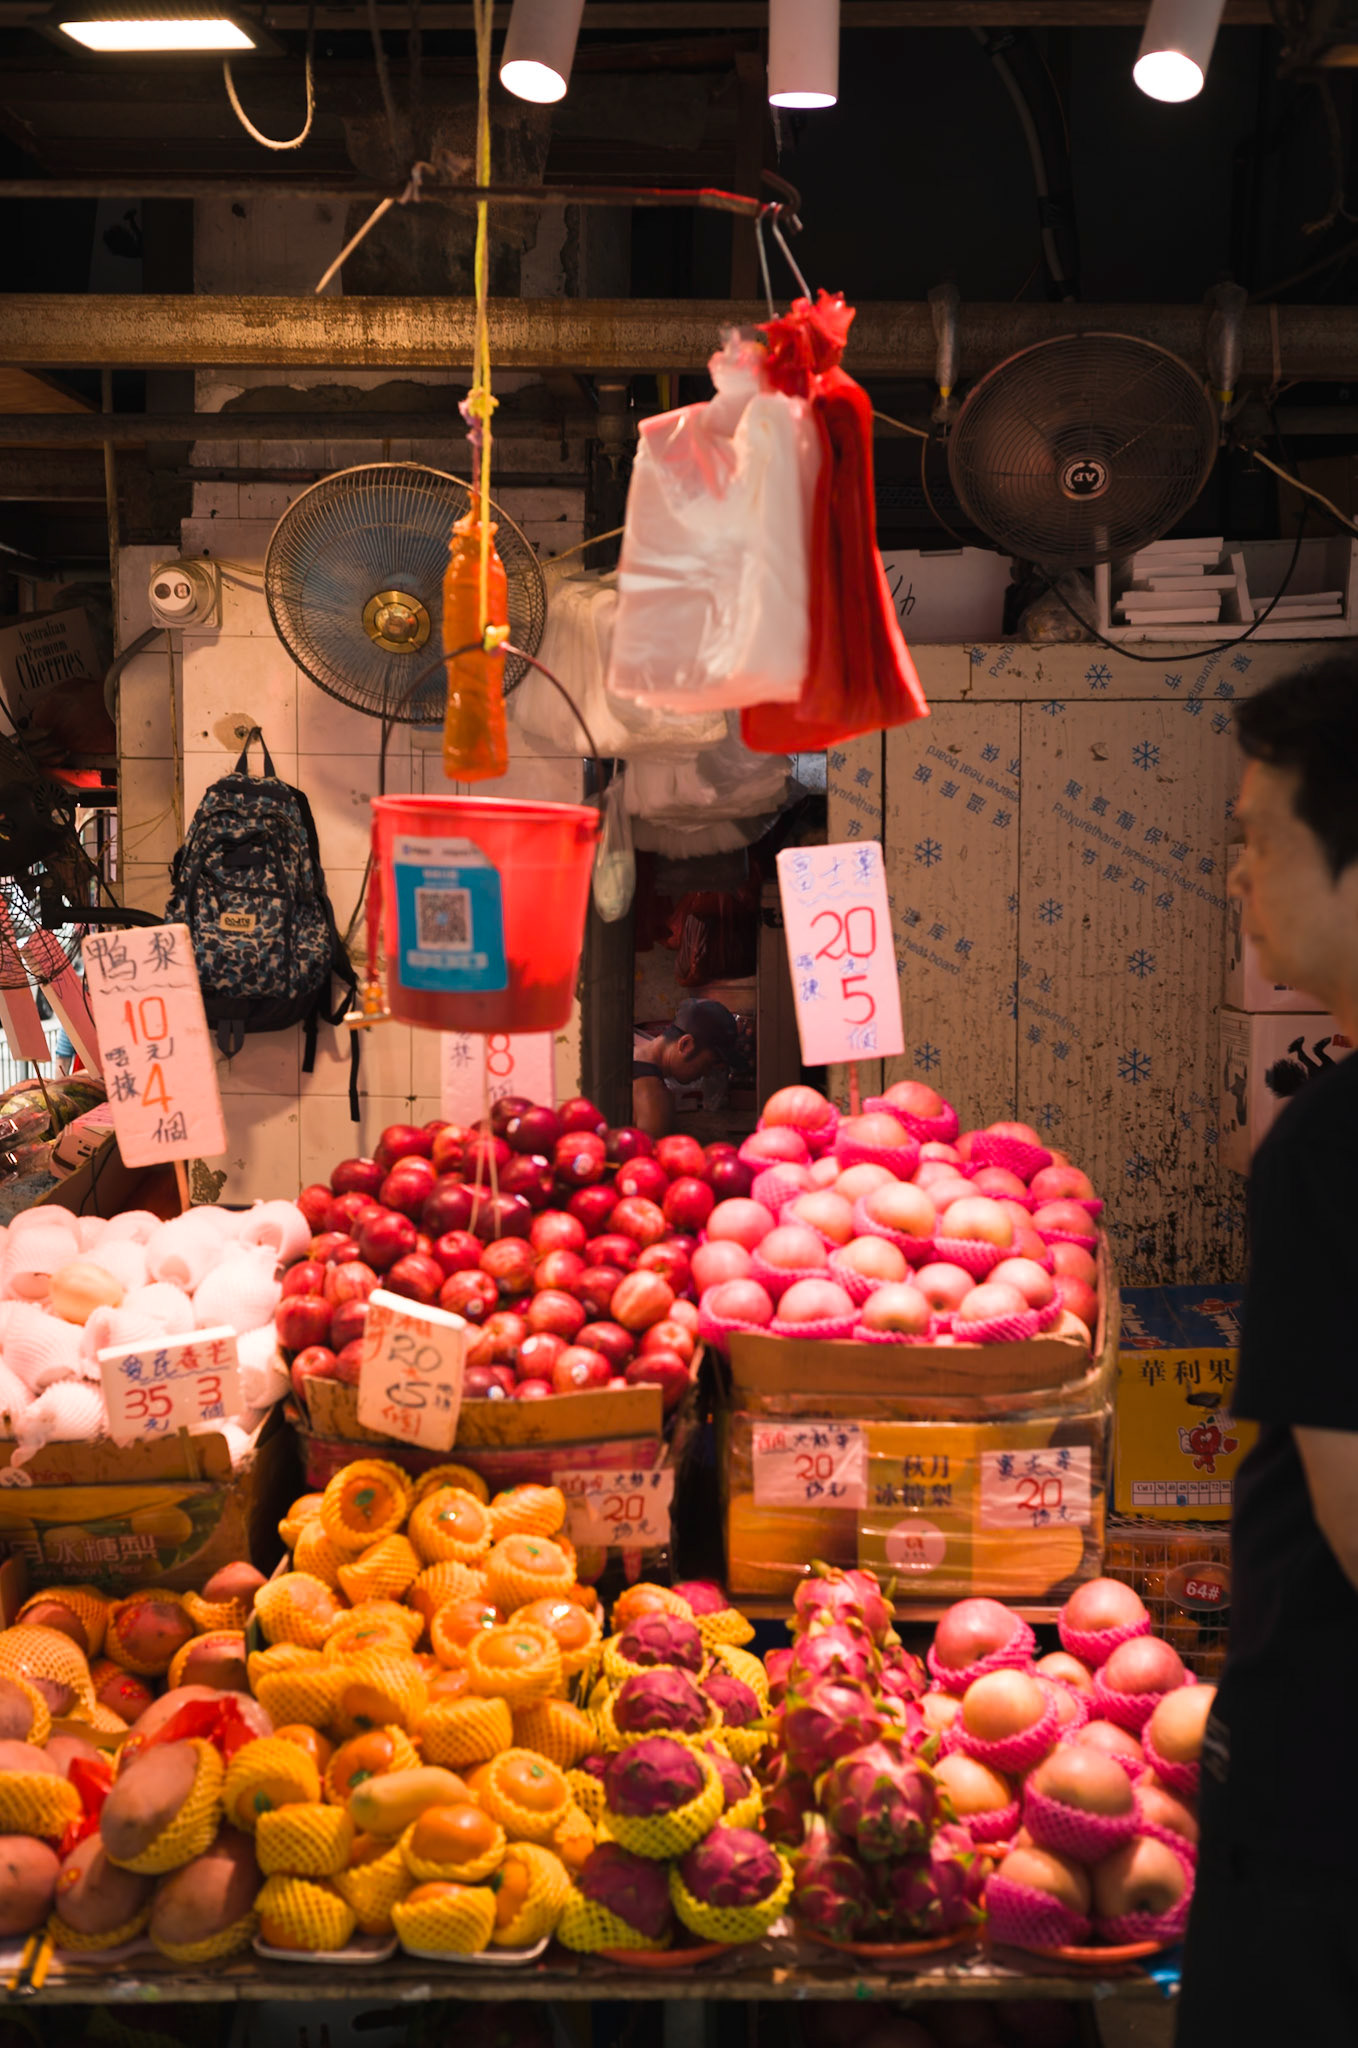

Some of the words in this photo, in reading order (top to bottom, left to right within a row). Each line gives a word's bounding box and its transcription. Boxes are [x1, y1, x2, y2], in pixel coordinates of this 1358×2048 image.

[18, 621, 66, 645] Australian
[25, 640, 68, 660] Premium
[15, 649, 86, 691] Cherries
[912, 762, 1012, 829] 保温库板
[1052, 801, 1123, 851] Polyurethane
[1081, 846, 1175, 912] 节能环保
[810, 906, 877, 961] 20
[840, 974, 876, 1026] 5
[122, 995, 169, 1046] 10
[141, 1063, 175, 1114] 4
[151, 1110, 188, 1144] 個
[124, 1384, 173, 1420] 35
[197, 1376, 221, 1406] 3
[794, 1453, 834, 1481] 20
[903, 1454, 949, 1479] 秋月
[603, 1494, 646, 1522] 20
[875, 1482, 953, 1507] 冰糖梨
[1015, 1477, 1062, 1510] 20
[1186, 1581, 1220, 1600] 64#
